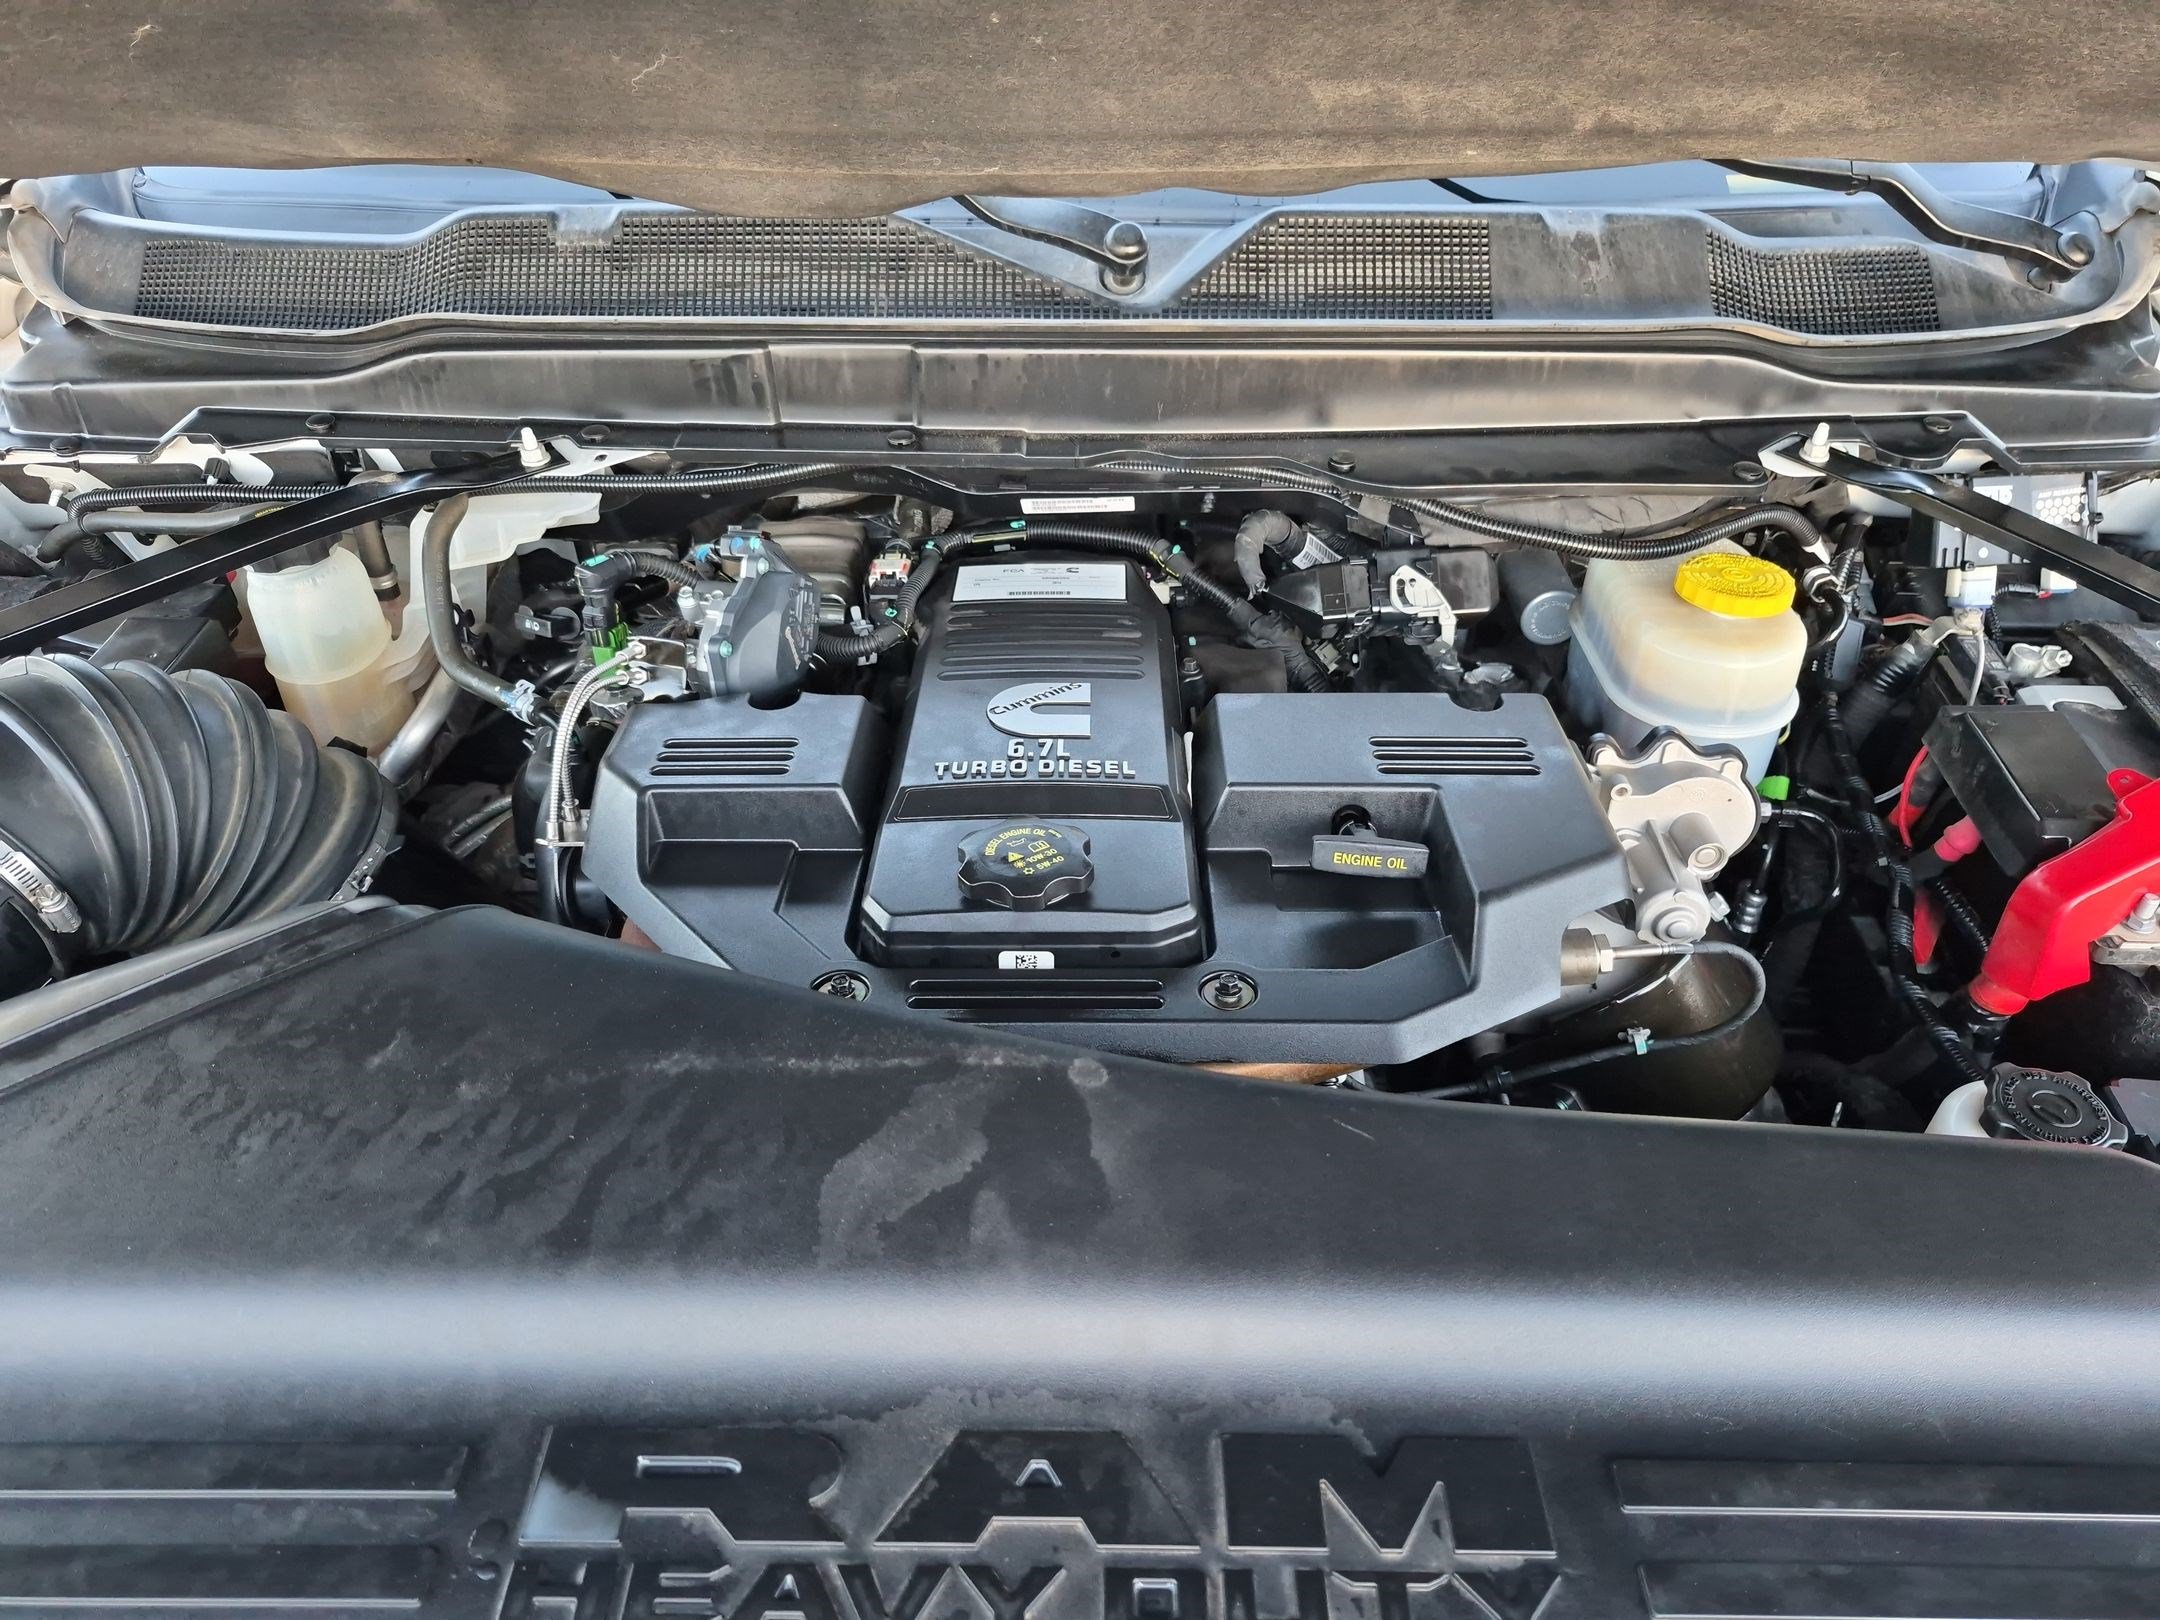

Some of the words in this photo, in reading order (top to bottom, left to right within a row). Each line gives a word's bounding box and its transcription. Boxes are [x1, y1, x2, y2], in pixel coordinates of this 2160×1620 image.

[989, 682, 1082, 715] Cummins
[1007, 738, 1071, 760] 6.7L
[934, 759, 1028, 779] TURBO
[1038, 759, 1136, 779] DIESEL
[998, 827, 1032, 840] ENGINE
[1032, 828, 1047, 837] OIL
[1026, 848, 1058, 863] 10W-30
[1036, 855, 1065, 870] 5W-40
[1333, 852, 1383, 868] ENGINE
[1387, 857, 1408, 870] OIL
[516, 1424, 1558, 1560] RAM
[492, 1560, 1067, 1620] HEAVY
[1102, 1567, 1563, 1620] DUTY
